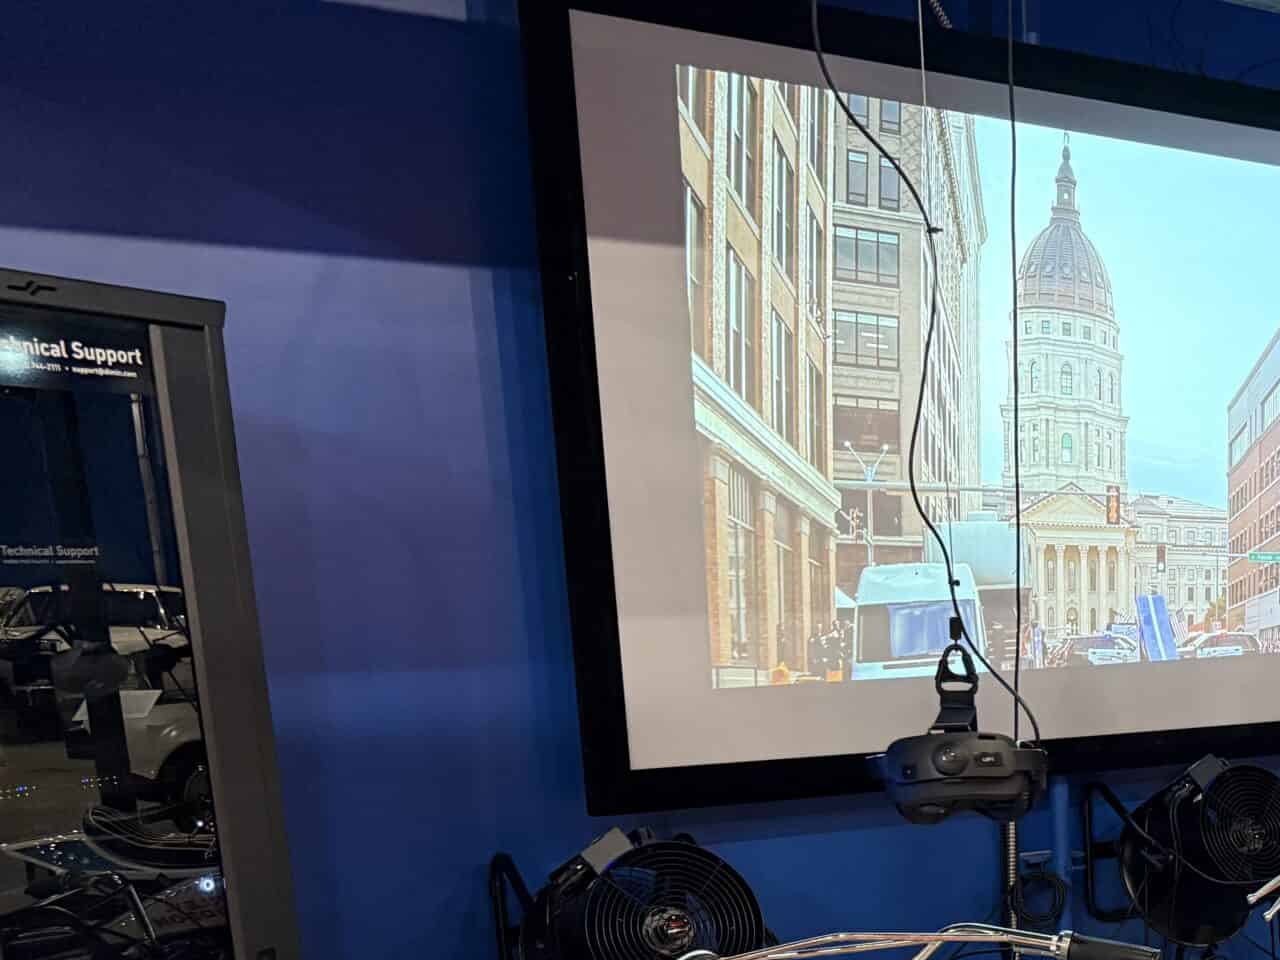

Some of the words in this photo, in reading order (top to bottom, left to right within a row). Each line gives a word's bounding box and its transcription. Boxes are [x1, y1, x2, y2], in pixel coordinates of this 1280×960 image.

[71, 341, 143, 366] Support
[0, 545, 53, 557] Technical
[56, 545, 99, 558] Support
